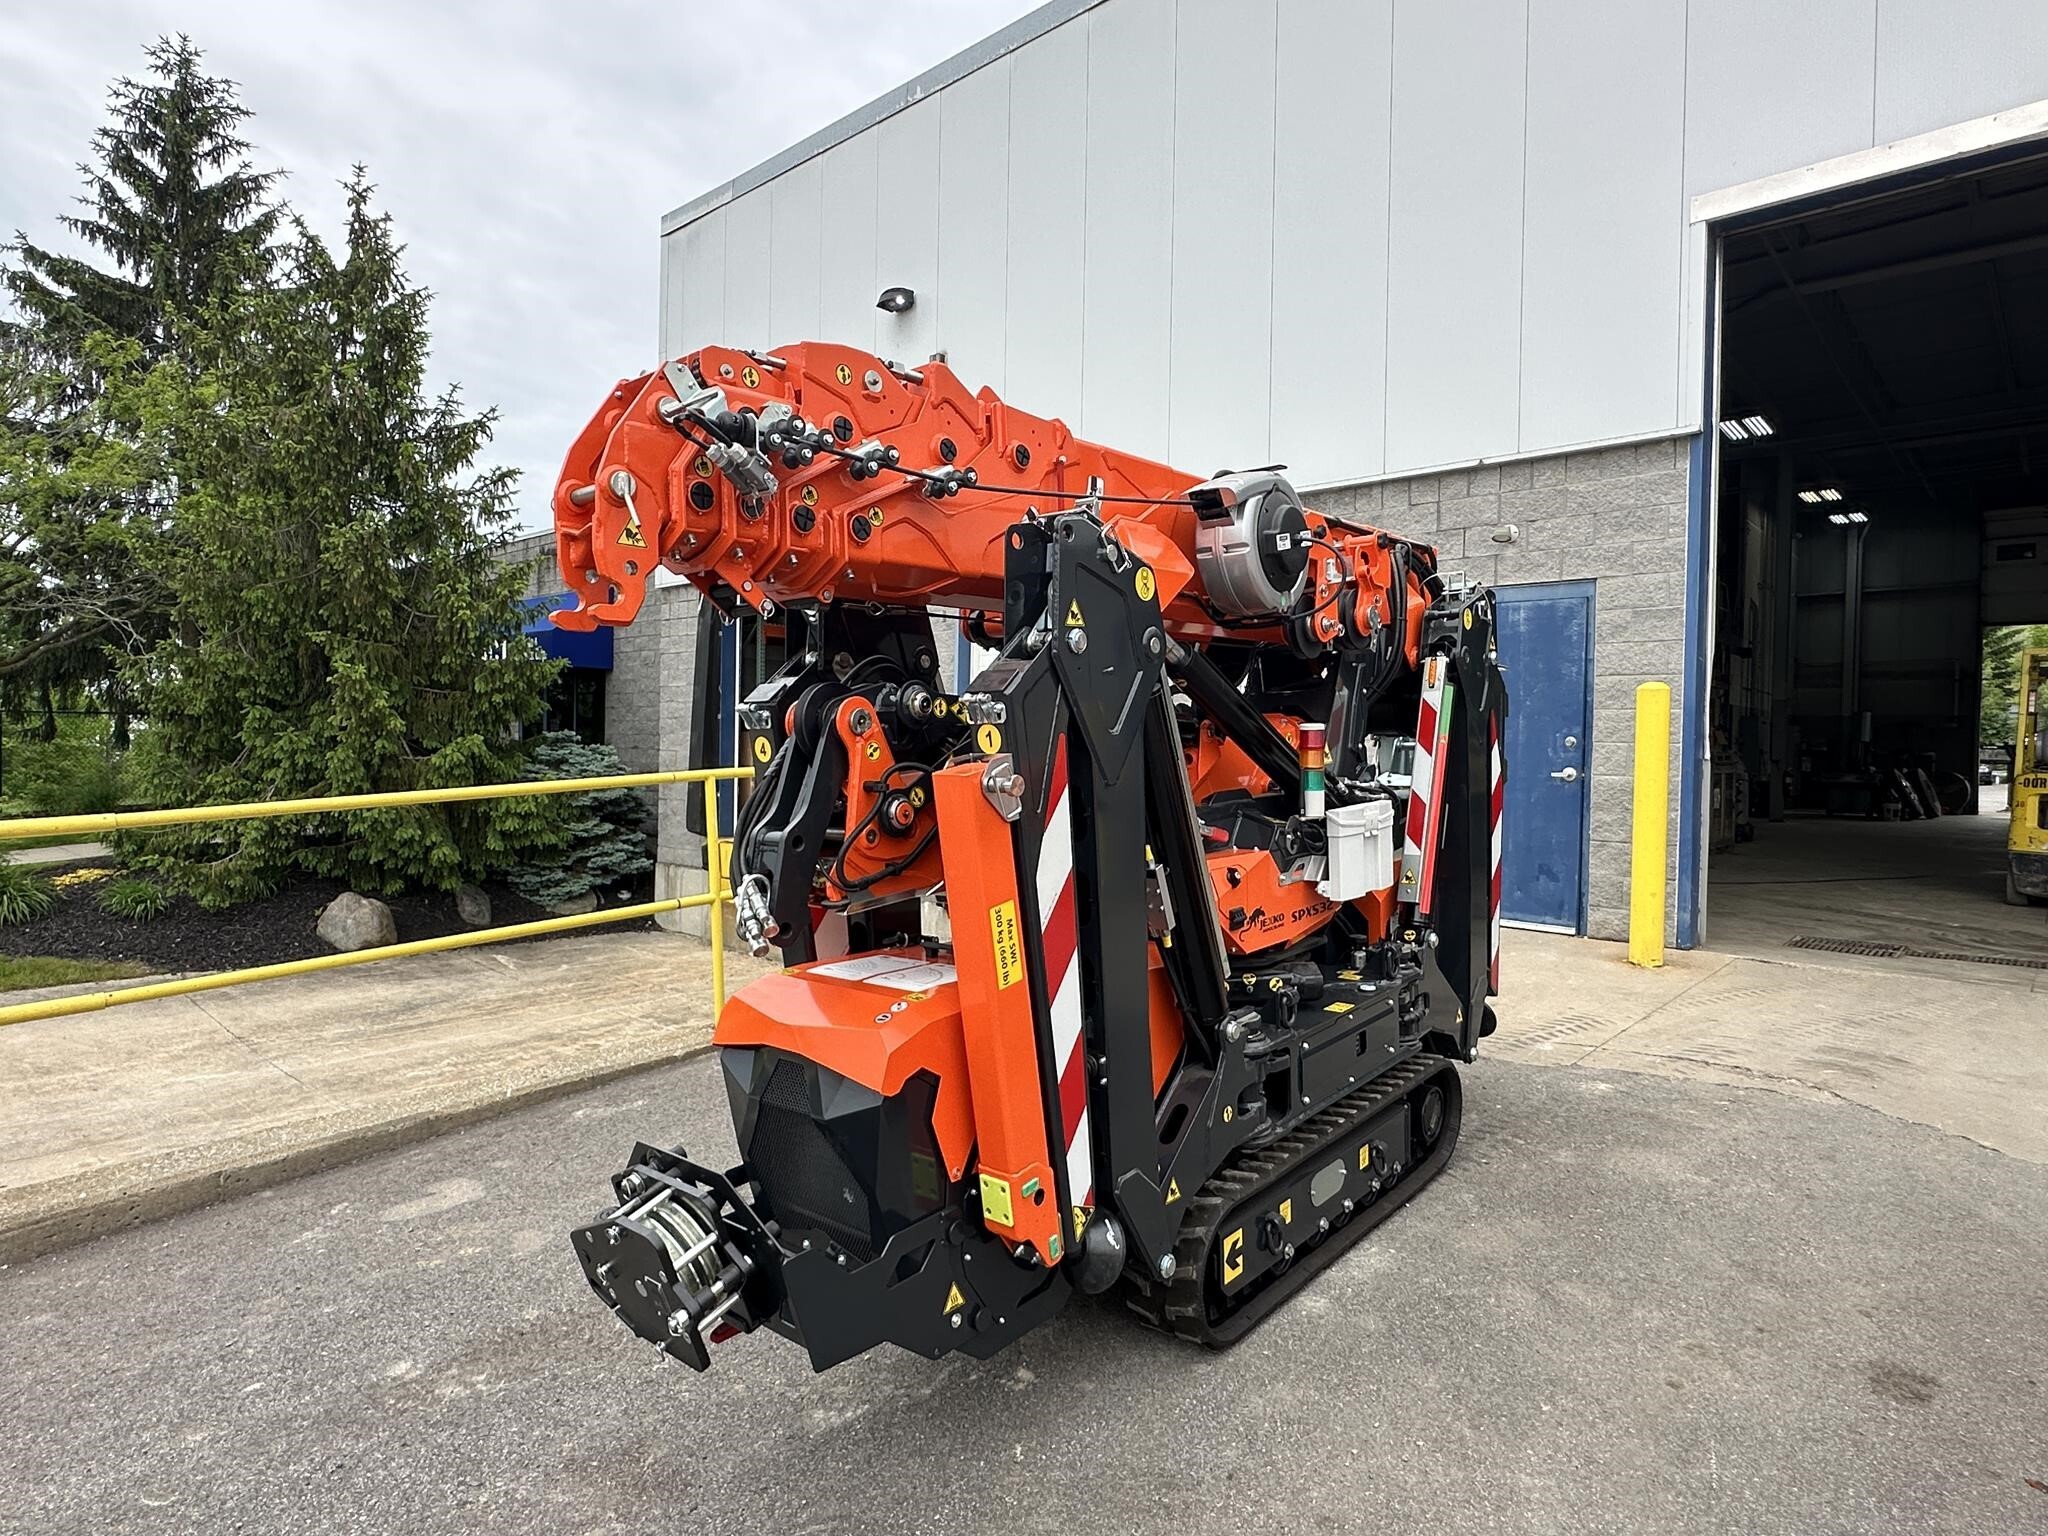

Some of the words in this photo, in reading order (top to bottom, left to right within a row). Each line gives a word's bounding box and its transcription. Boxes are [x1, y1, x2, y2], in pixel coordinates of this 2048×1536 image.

[985, 730, 993, 748] 1
[760, 742, 767, 757] 4
[995, 907, 1003, 928] 300
[996, 930, 1004, 944] kg
[1006, 918, 1014, 941] Max
[999, 945, 1008, 970] (660
[1009, 943, 1018, 967] SWL
[1002, 970, 1011, 986] lb)
